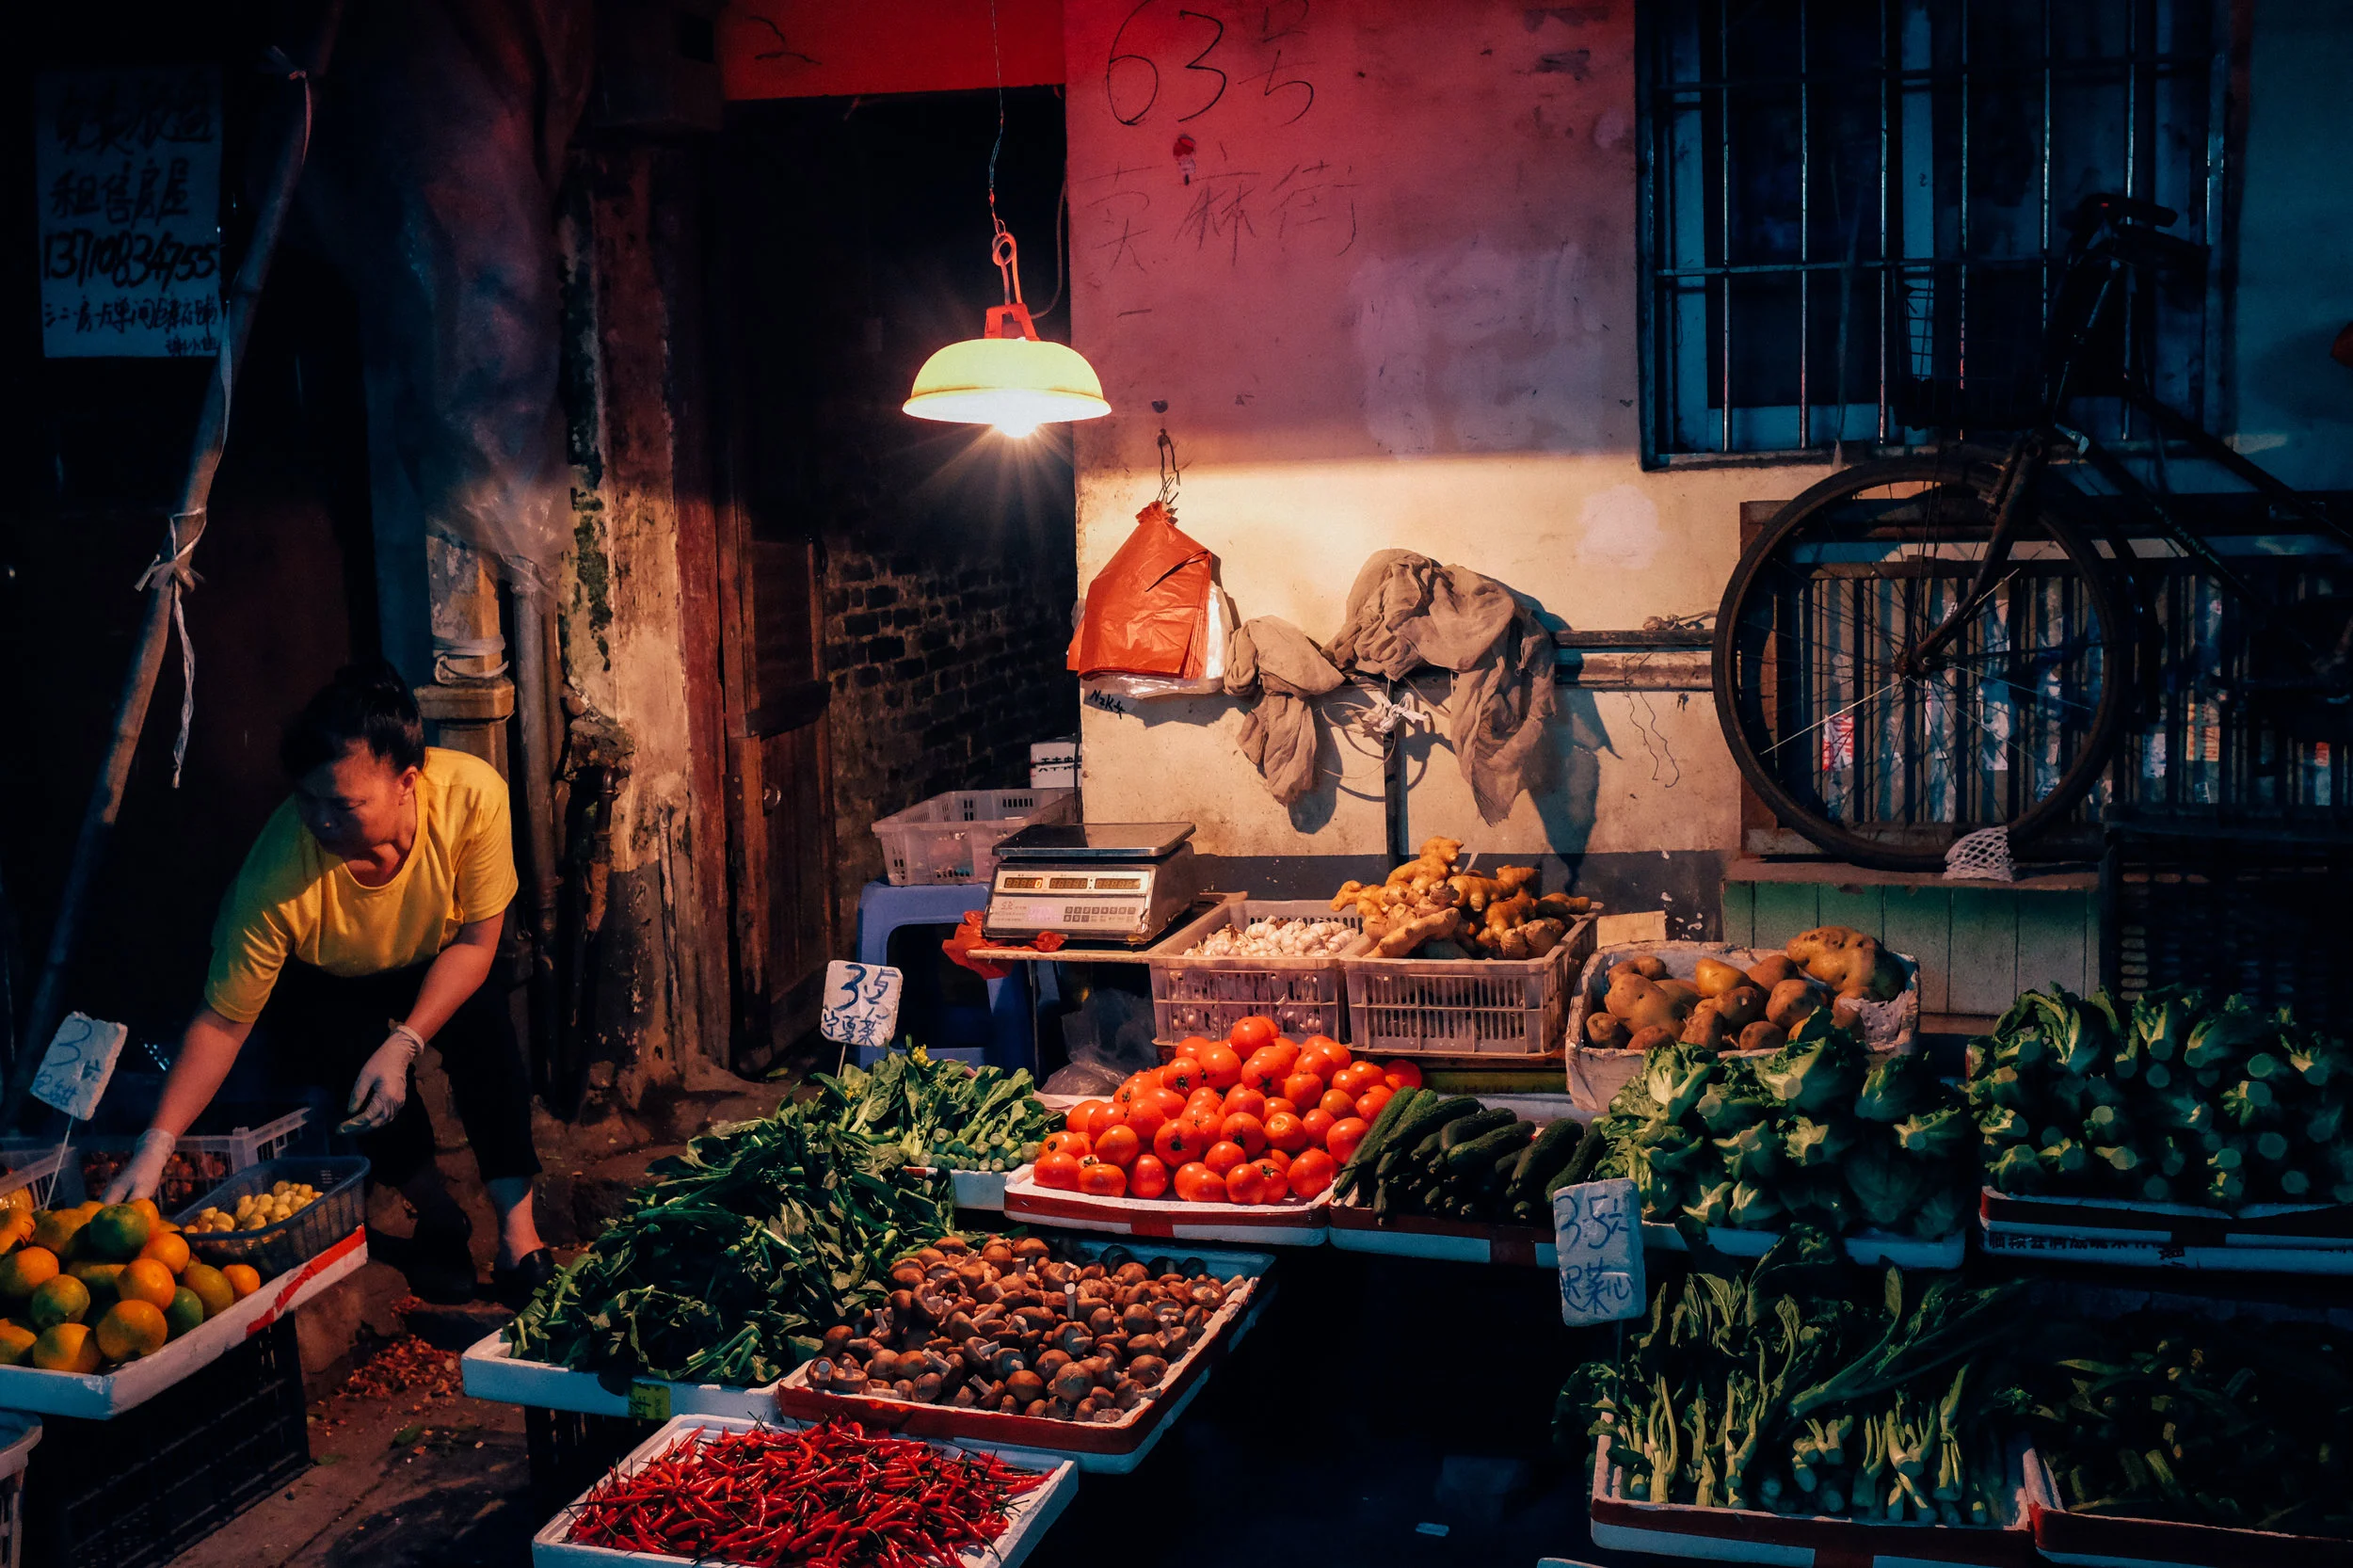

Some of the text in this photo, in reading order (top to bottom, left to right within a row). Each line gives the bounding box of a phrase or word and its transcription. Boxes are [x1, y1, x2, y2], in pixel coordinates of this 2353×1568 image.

[49, 158, 190, 226] 租售房屋
[45, 229, 219, 292] 13710834755
